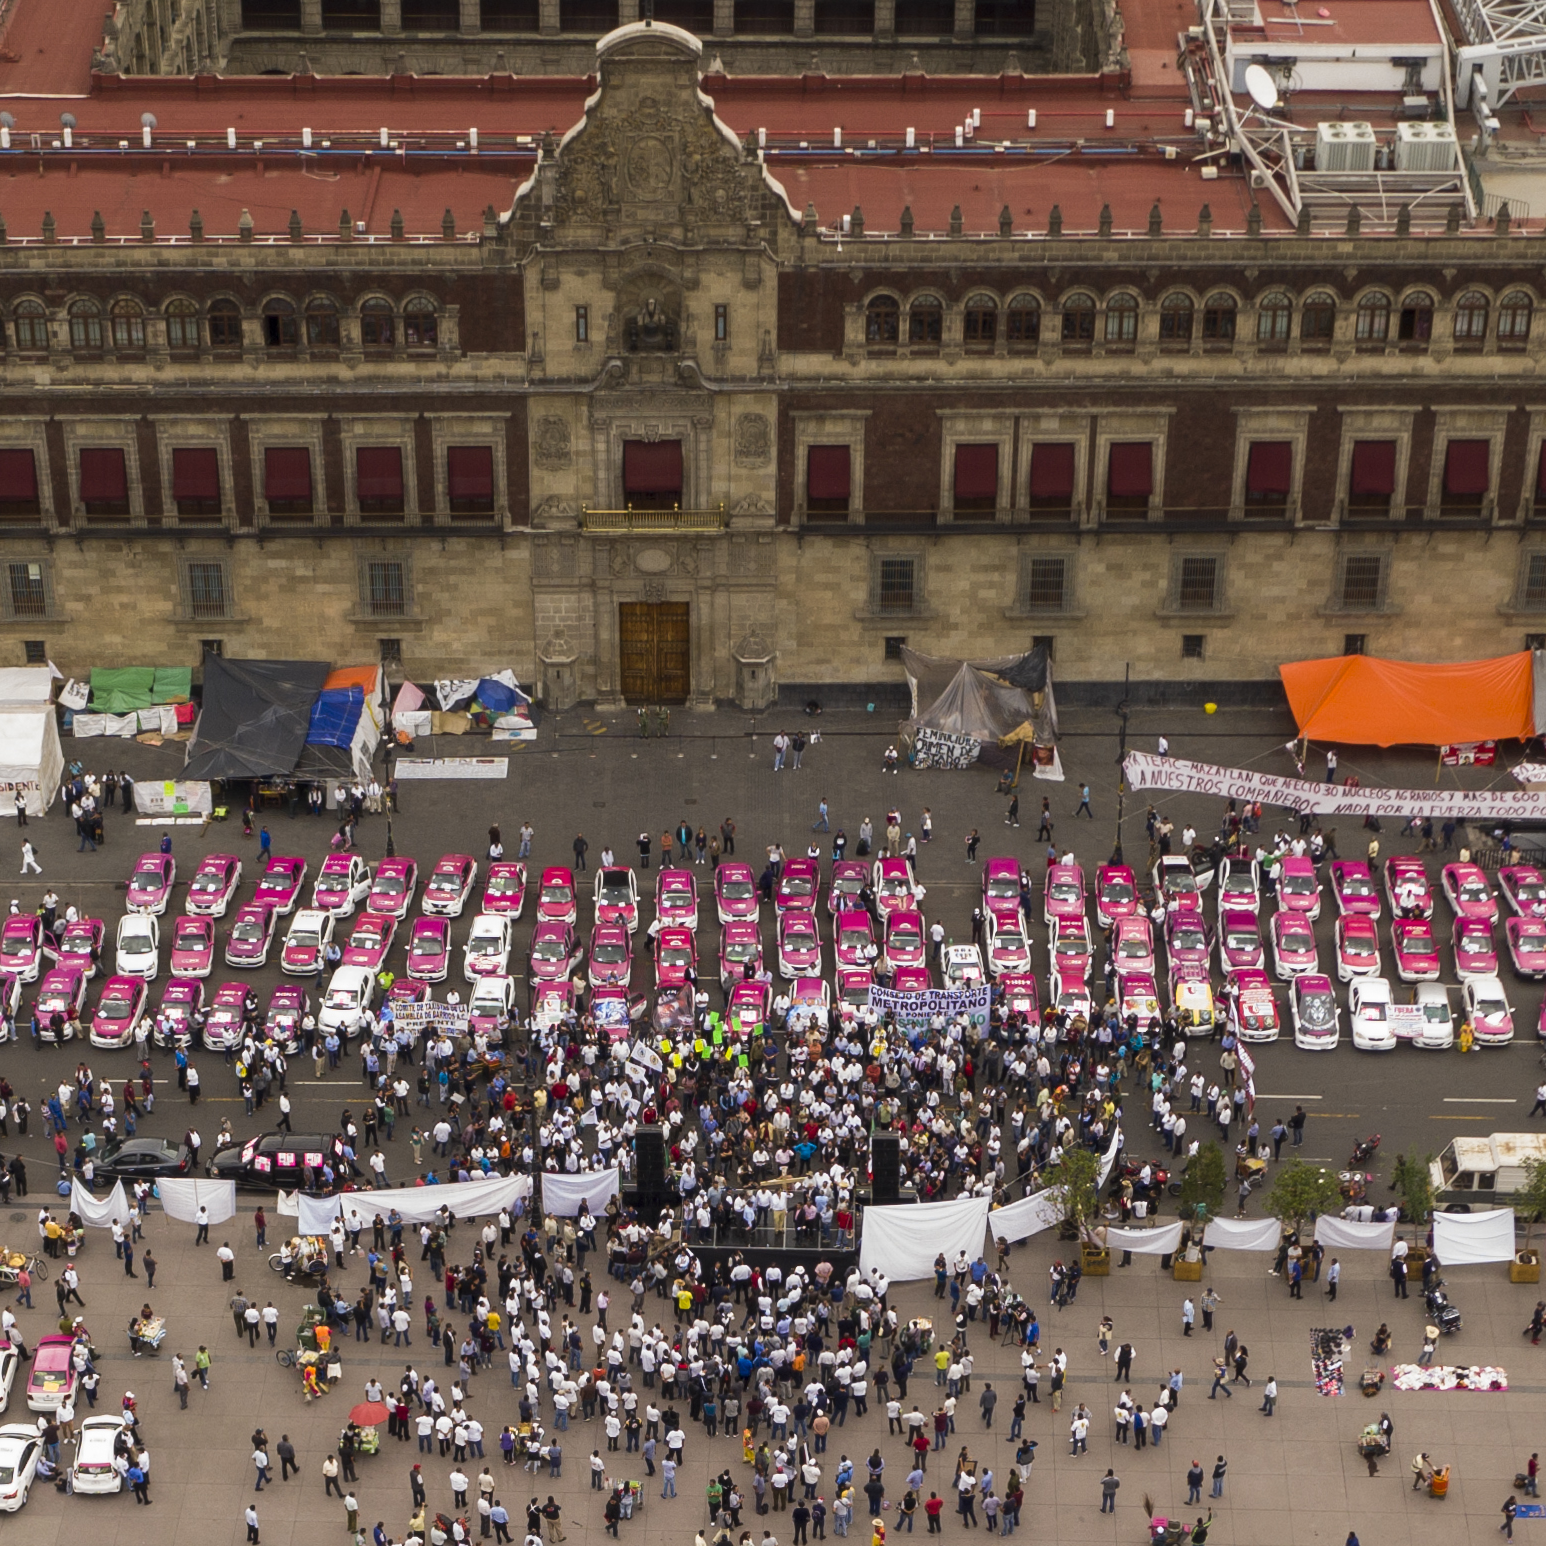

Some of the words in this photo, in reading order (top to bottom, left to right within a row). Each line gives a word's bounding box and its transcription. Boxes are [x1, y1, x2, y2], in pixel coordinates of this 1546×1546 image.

[1140, 769, 1148, 786] A
[1150, 769, 1222, 794] NUESTROS
[1334, 803, 1370, 814] NADA
[1376, 804, 1404, 815] POR
[1410, 806, 1424, 816] LA
[1430, 806, 1482, 817] FUERZA
[1488, 806, 1526, 817] TODO
[1259, 775, 1278, 788] QUE
[1280, 778, 1321, 794] AFECTO
[1322, 786, 1338, 798] 30
[1446, 792, 1454, 802] Y
[1491, 792, 1505, 802] DE
[1513, 793, 1539, 803] 600
[870, 986, 912, 1000] CONSEJO
[915, 992, 926, 1000] DE
[929, 986, 988, 1000] TRANSPORTE
[872, 996, 987, 1012] METROPOLITANO
